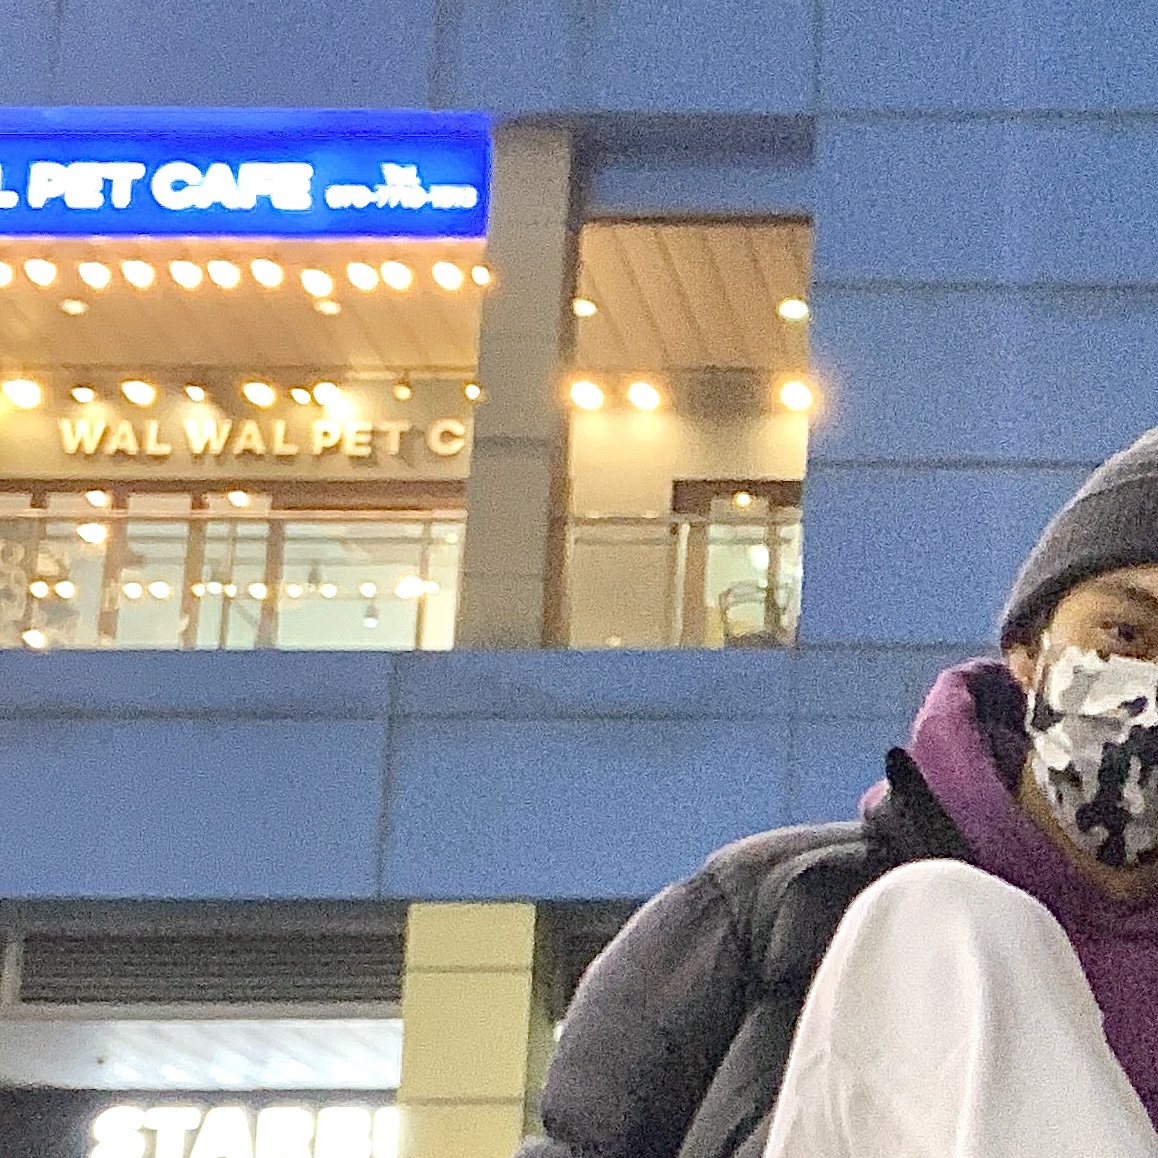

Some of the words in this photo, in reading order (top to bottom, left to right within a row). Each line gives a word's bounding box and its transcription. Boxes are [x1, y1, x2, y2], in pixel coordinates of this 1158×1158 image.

[28, 161, 146, 209] PET
[151, 161, 314, 210] CAFE
[59, 418, 171, 456] WAL
[183, 418, 299, 456] WAL
[312, 419, 409, 457] PET
[427, 419, 466, 456] C
